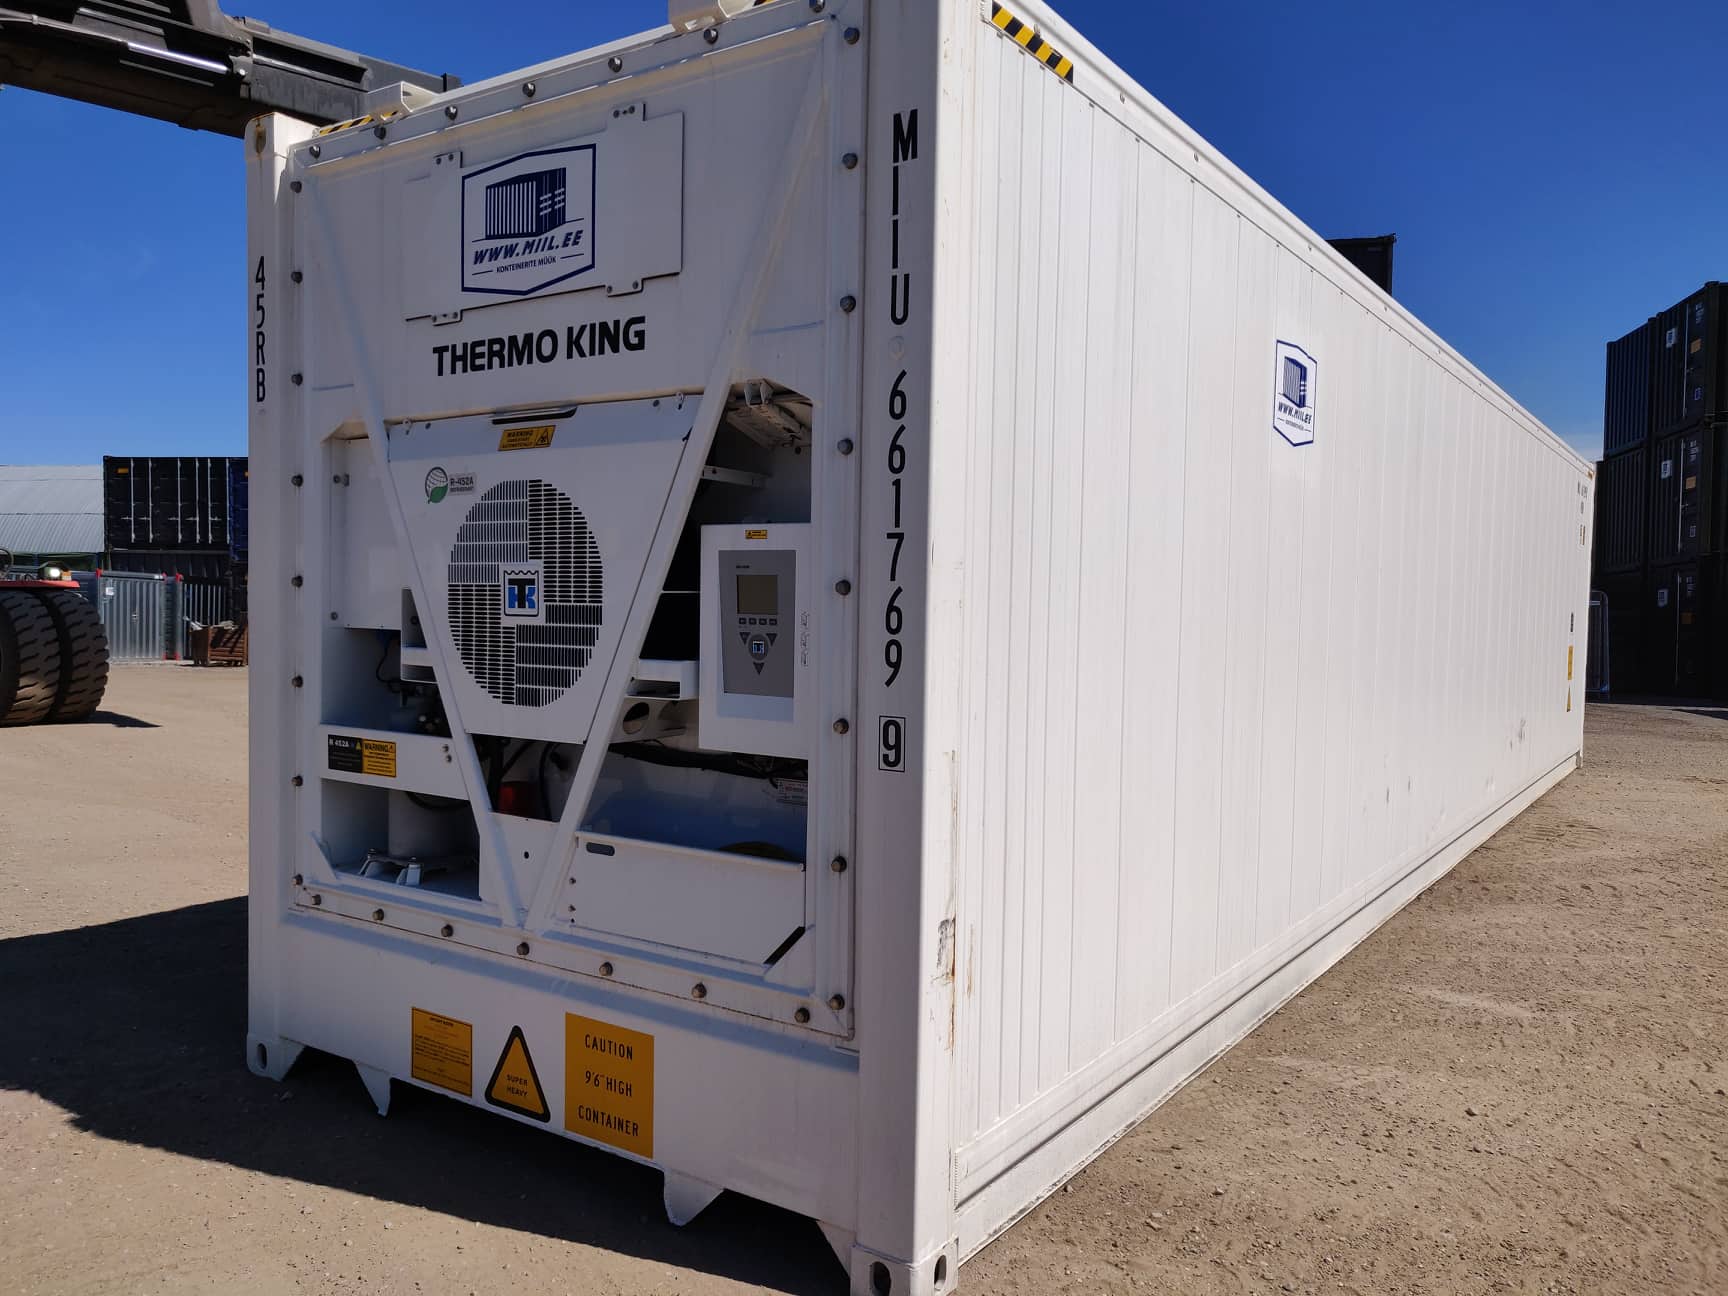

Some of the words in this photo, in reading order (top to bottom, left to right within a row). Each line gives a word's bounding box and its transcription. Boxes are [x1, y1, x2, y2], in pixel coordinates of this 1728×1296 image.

[890, 108, 918, 326] MIIU
[472, 230, 584, 265] WWW.MIIL.EE
[496, 259, 537, 274] KONTEINERITE
[255, 255, 266, 403] 45RB
[432, 328, 558, 377] THERMO
[566, 315, 646, 360] KING
[884, 369, 908, 688] 661769
[881, 719, 902, 768] 9
[585, 1034, 633, 1061] CAUTION
[506, 1073, 529, 1085] SUPER
[506, 1085, 529, 1098] HEAVY
[606, 1076, 633, 1098] HIGH
[578, 1104, 640, 1137] CONTAINER
